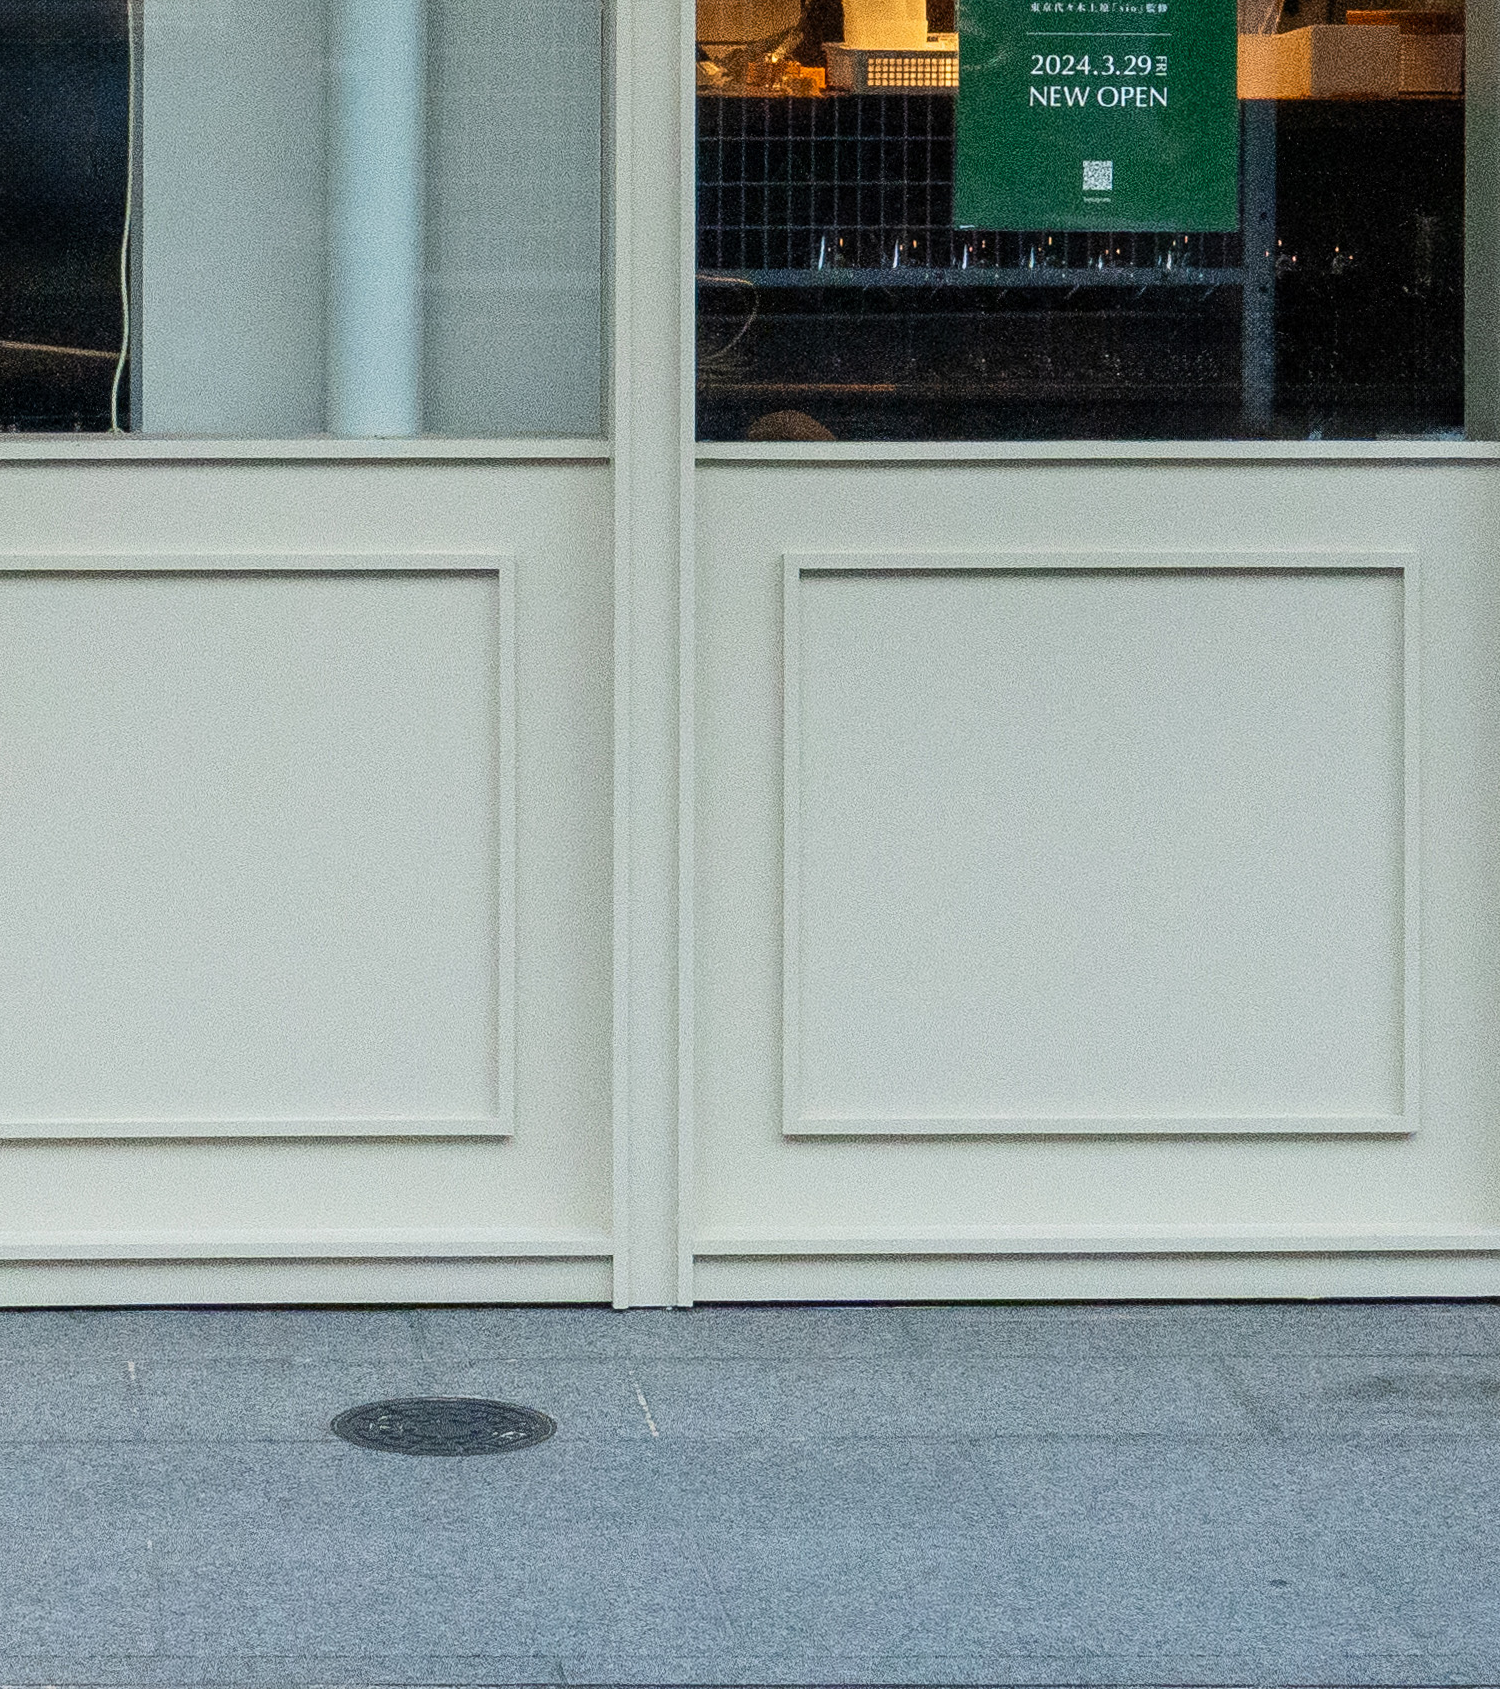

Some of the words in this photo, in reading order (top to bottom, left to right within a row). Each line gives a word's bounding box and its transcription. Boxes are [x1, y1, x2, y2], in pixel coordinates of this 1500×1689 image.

[1031, 54, 1152, 76] 2024.3.29
[1156, 56, 1168, 76] FRI
[1029, 86, 1090, 107] NEW
[1096, 86, 1167, 108] OPEN
